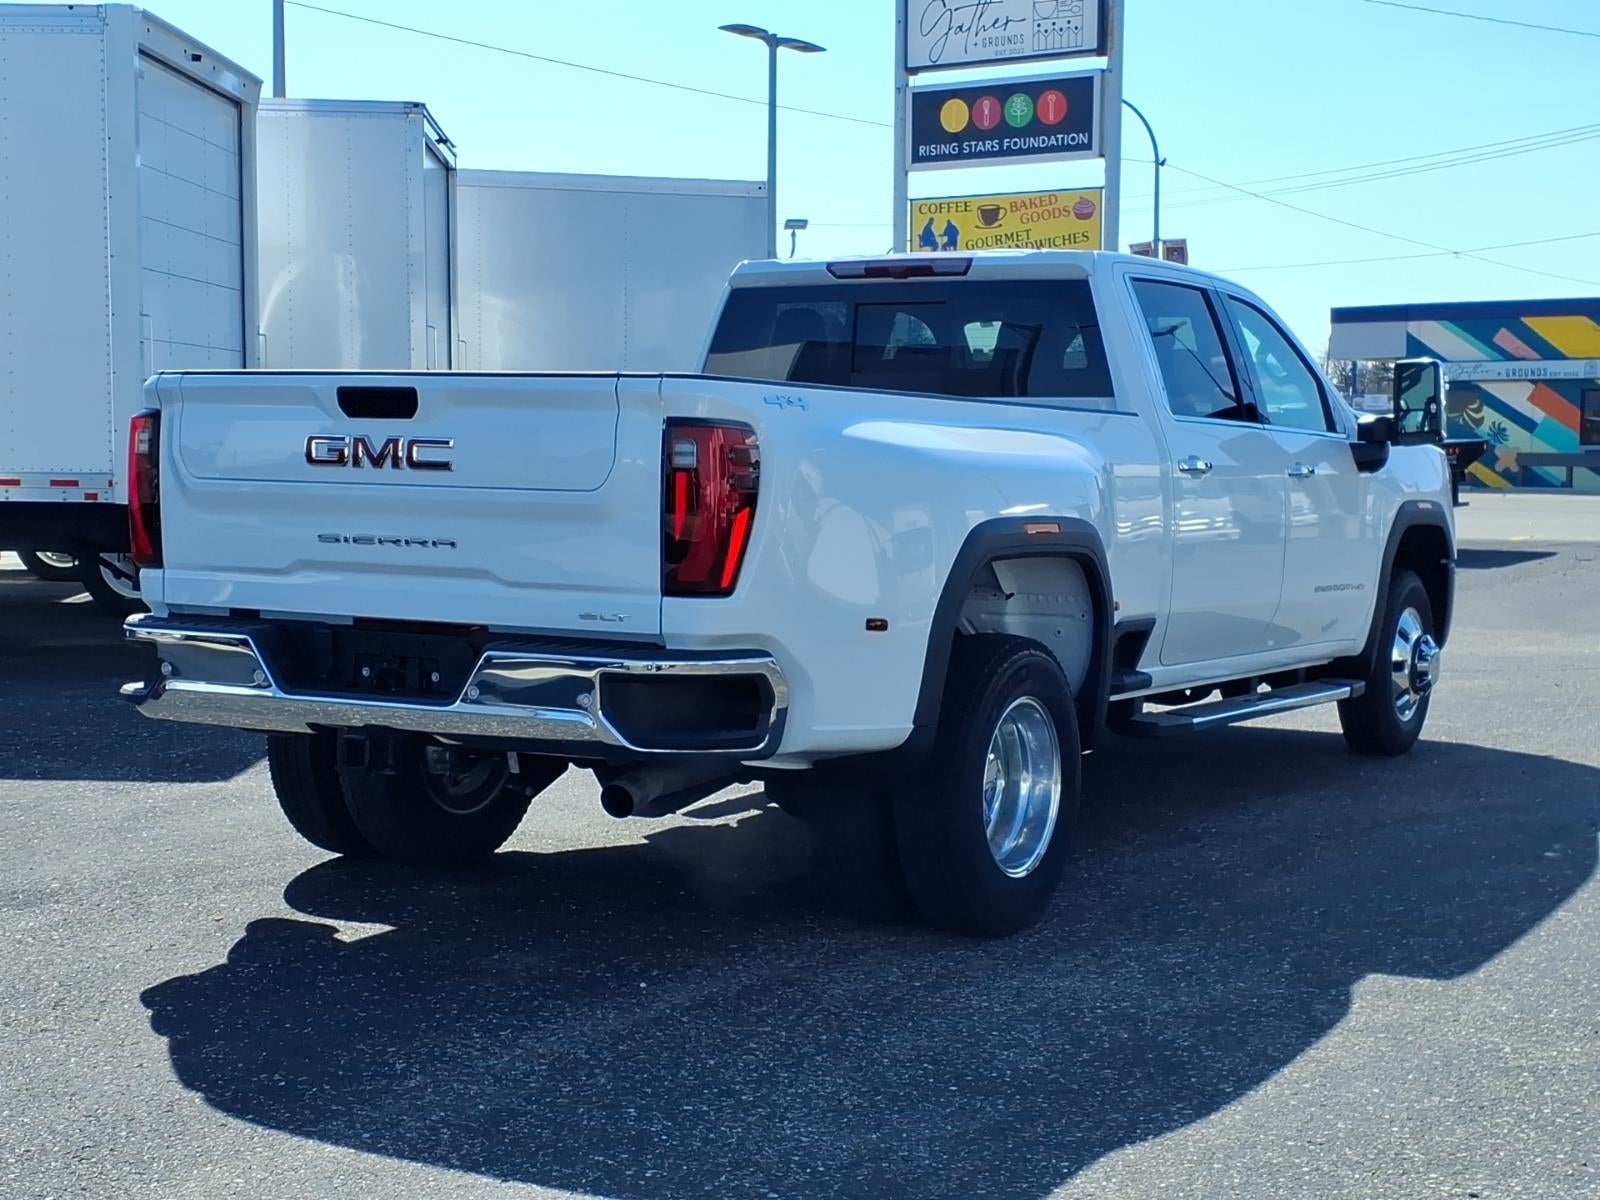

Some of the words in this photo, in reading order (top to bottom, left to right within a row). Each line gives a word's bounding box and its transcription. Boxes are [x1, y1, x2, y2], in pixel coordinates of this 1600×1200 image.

[920, 0, 1026, 63] Gather
[982, 33, 1025, 48] GROUNDS
[919, 142, 959, 157] RISING
[962, 139, 1000, 154] STARS
[1003, 132, 1089, 151] FOUNDATION
[918, 200, 973, 216] COFFEE
[1009, 193, 1059, 213] BAKED
[1020, 205, 1071, 225] GOODS
[965, 229, 1032, 251] GOURMET
[999, 231, 1090, 250] NDWICHES
[1505, 367, 1548, 378] GROUNDS
[304, 434, 455, 472] GMC
[317, 532, 458, 549] SIERRA
[578, 612, 631, 623] SLT
